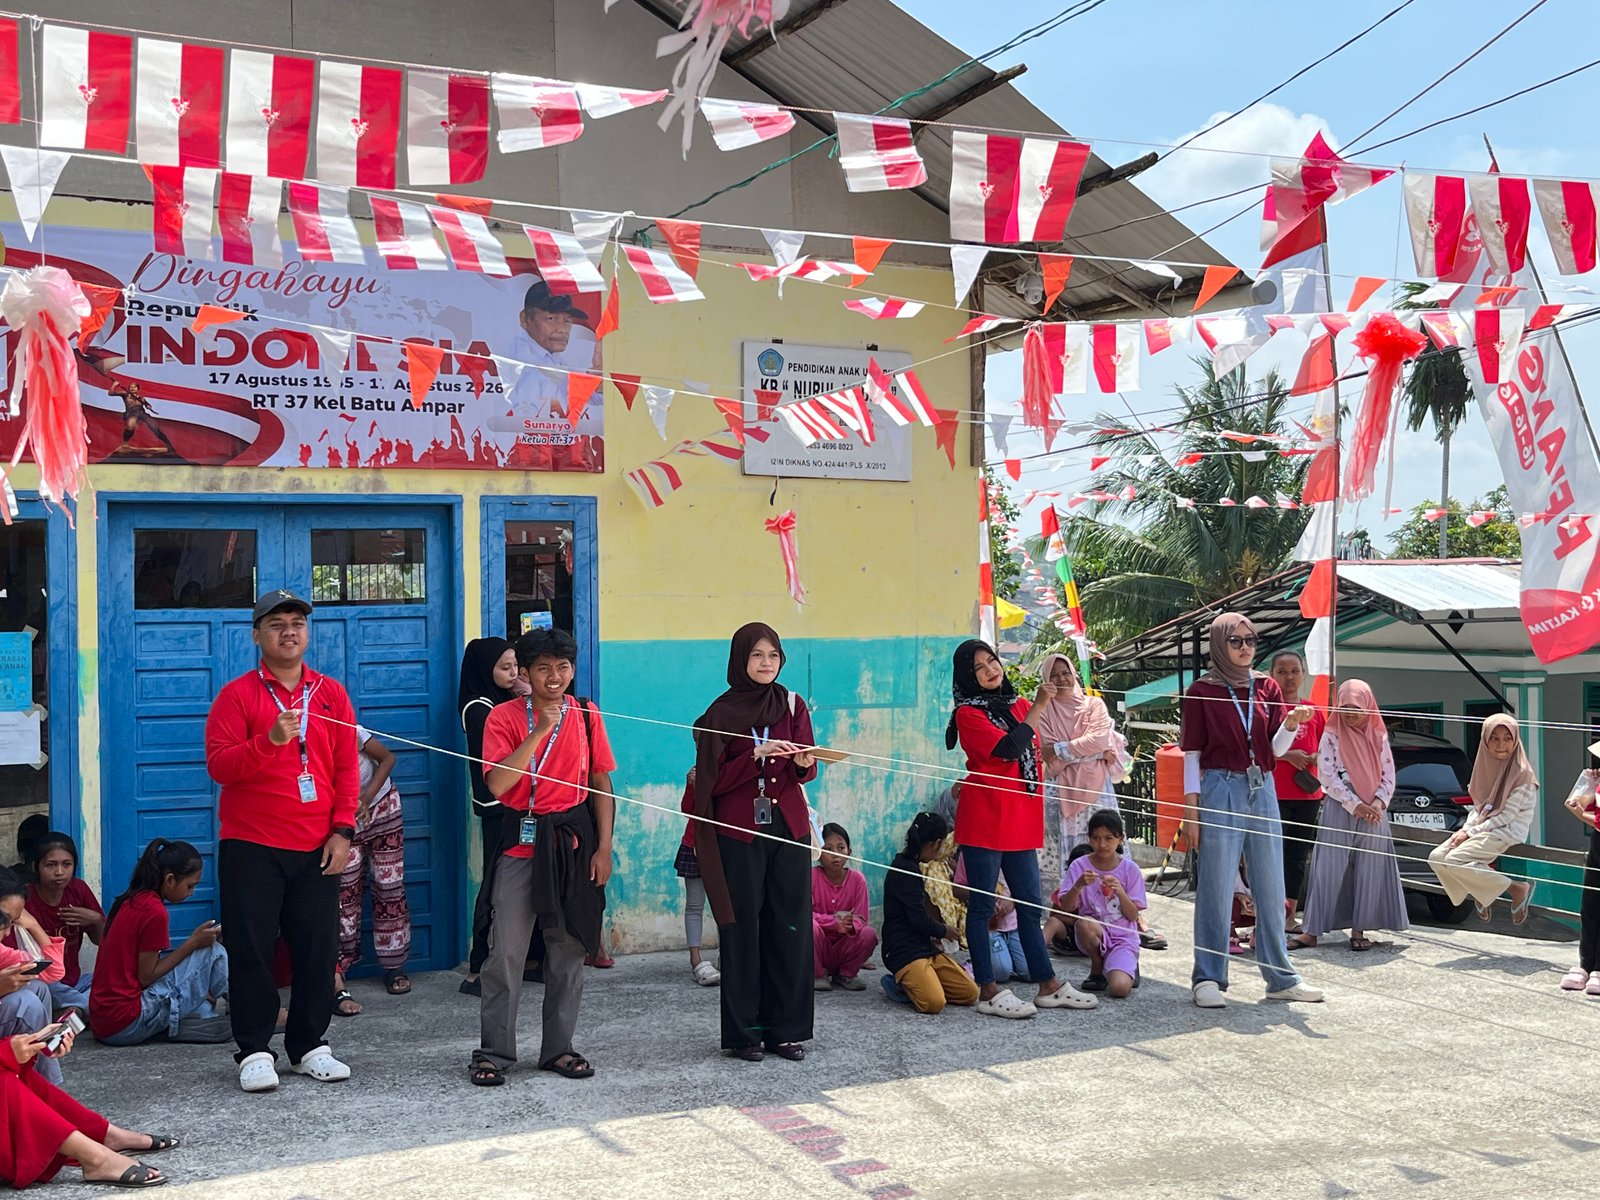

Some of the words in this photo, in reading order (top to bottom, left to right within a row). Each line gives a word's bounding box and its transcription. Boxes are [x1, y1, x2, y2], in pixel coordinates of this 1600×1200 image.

[132, 252, 382, 309] Dirgahayu
[127, 300, 259, 322] Repuk
[788, 362, 835, 375] PENDIDIKAN
[838, 366, 860, 376] ANAK
[209, 372, 230, 384] 17
[235, 373, 308, 388] Agustus
[313, 376, 354, 389] 195
[394, 379, 461, 393] Agstus
[466, 382, 504, 394] 226
[253, 394, 279, 408] RT
[285, 396, 308, 409] 37
[314, 396, 345, 410] Kel
[351, 398, 396, 412] Batu
[524, 419, 571, 431] Sunaryo
[521, 435, 547, 444] Ketua
[770, 458, 784, 466] IZIN
[785, 459, 811, 467] DIKNAS
[1395, 815, 1405, 823] KT
